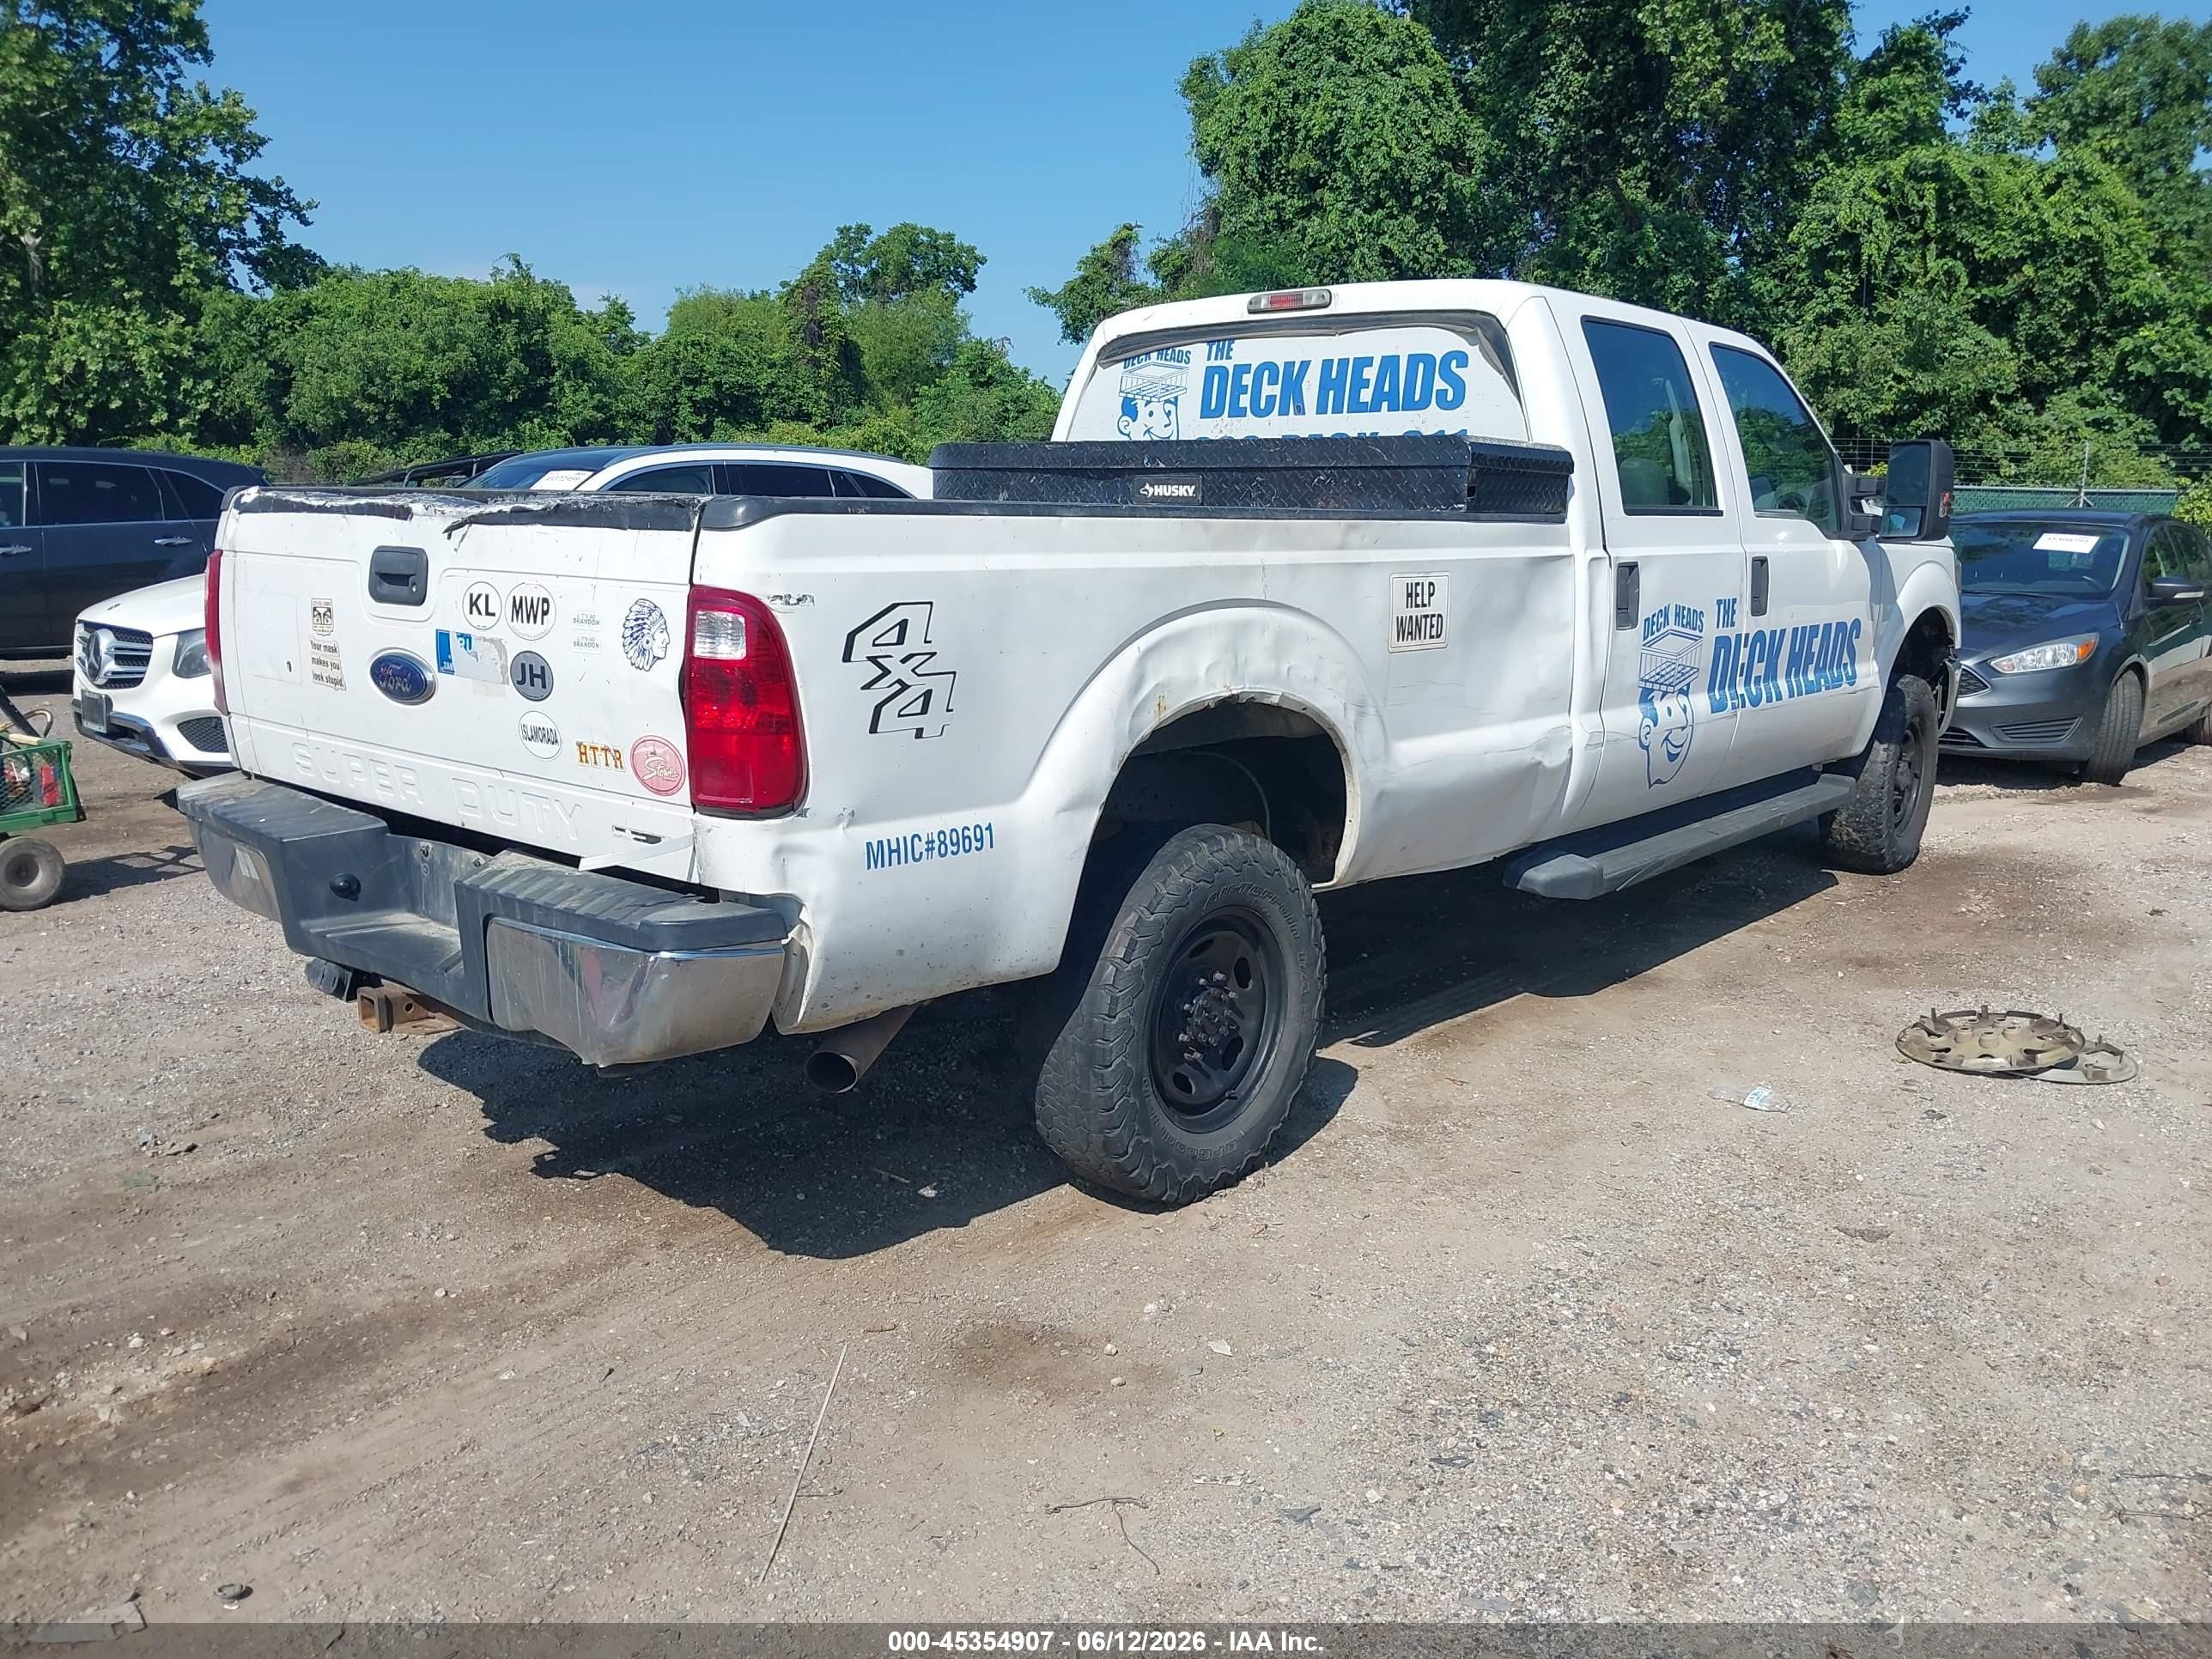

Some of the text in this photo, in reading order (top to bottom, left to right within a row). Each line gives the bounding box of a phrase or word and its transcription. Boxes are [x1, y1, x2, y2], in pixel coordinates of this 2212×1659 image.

[1156, 348, 1191, 364] HEADS
[1206, 338, 1235, 361] THE
[1201, 350, 1468, 419] DECK HEADS
[469, 592, 496, 617] KL
[1406, 581, 1436, 609] HELP
[511, 595, 550, 625] MWP
[573, 617, 600, 626] BRANDON
[1642, 603, 1705, 641] DECK HEADS
[1716, 598, 1738, 629] THE
[1396, 613, 1443, 643] WANTED
[309, 640, 338, 653] Your mask
[573, 641, 600, 649] BRANDON
[311, 657, 340, 671] makes you
[312, 671, 325, 682] look
[516, 662, 547, 690] JH
[1705, 617, 1862, 714] DECK HEADS
[379, 665, 412, 692] Ford
[520, 723, 560, 746] ISLAMORADA
[578, 744, 623, 769] HTTR
[293, 741, 582, 842] SUPER DUTY
[866, 822, 995, 871] MHIC#89691
